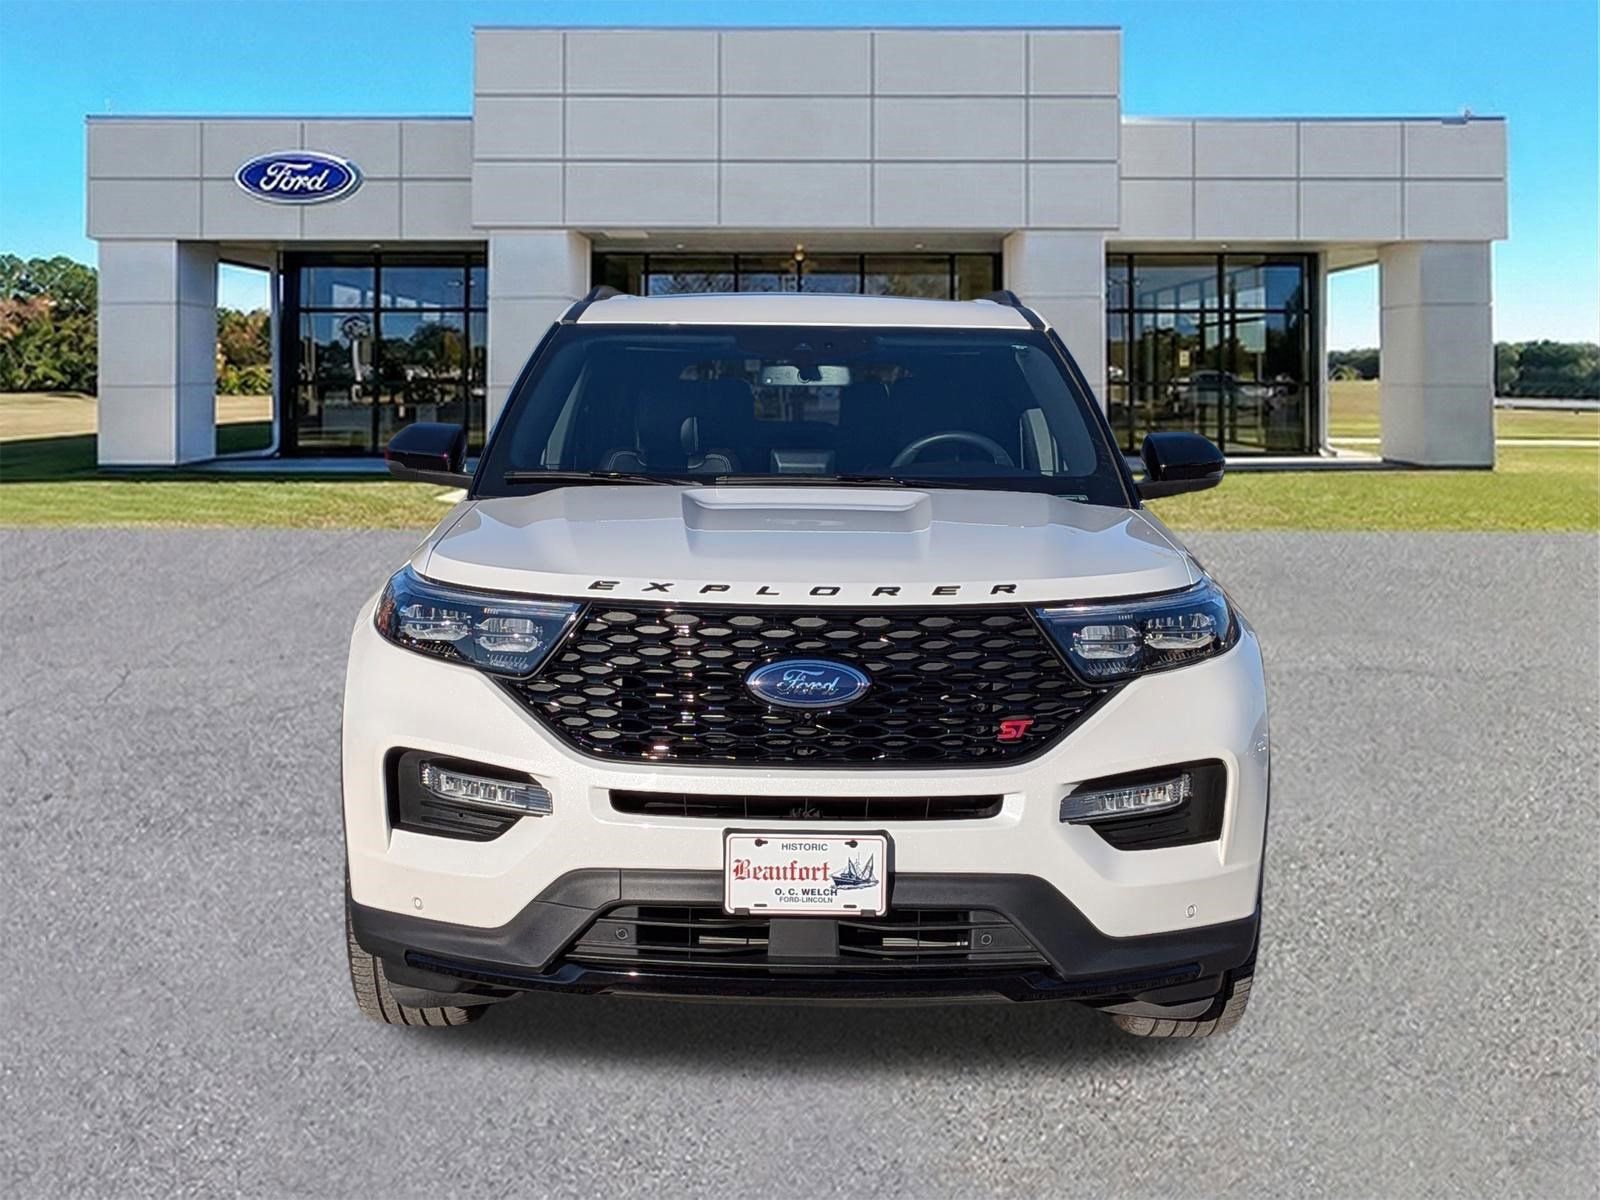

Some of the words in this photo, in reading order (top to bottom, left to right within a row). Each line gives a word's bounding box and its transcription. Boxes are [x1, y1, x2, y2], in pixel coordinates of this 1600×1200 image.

[260, 162, 330, 191] Ford
[587, 580, 1018, 597] EXPLORER
[776, 669, 840, 696] Ford
[997, 719, 1034, 739] ST
[781, 843, 828, 852] HISTORIC
[732, 858, 831, 882] Beaufort
[774, 888, 786, 896] O.
[788, 888, 799, 897] C.
[802, 888, 838, 897] WELCH
[779, 896, 834, 904] FORD-LINCOLN
